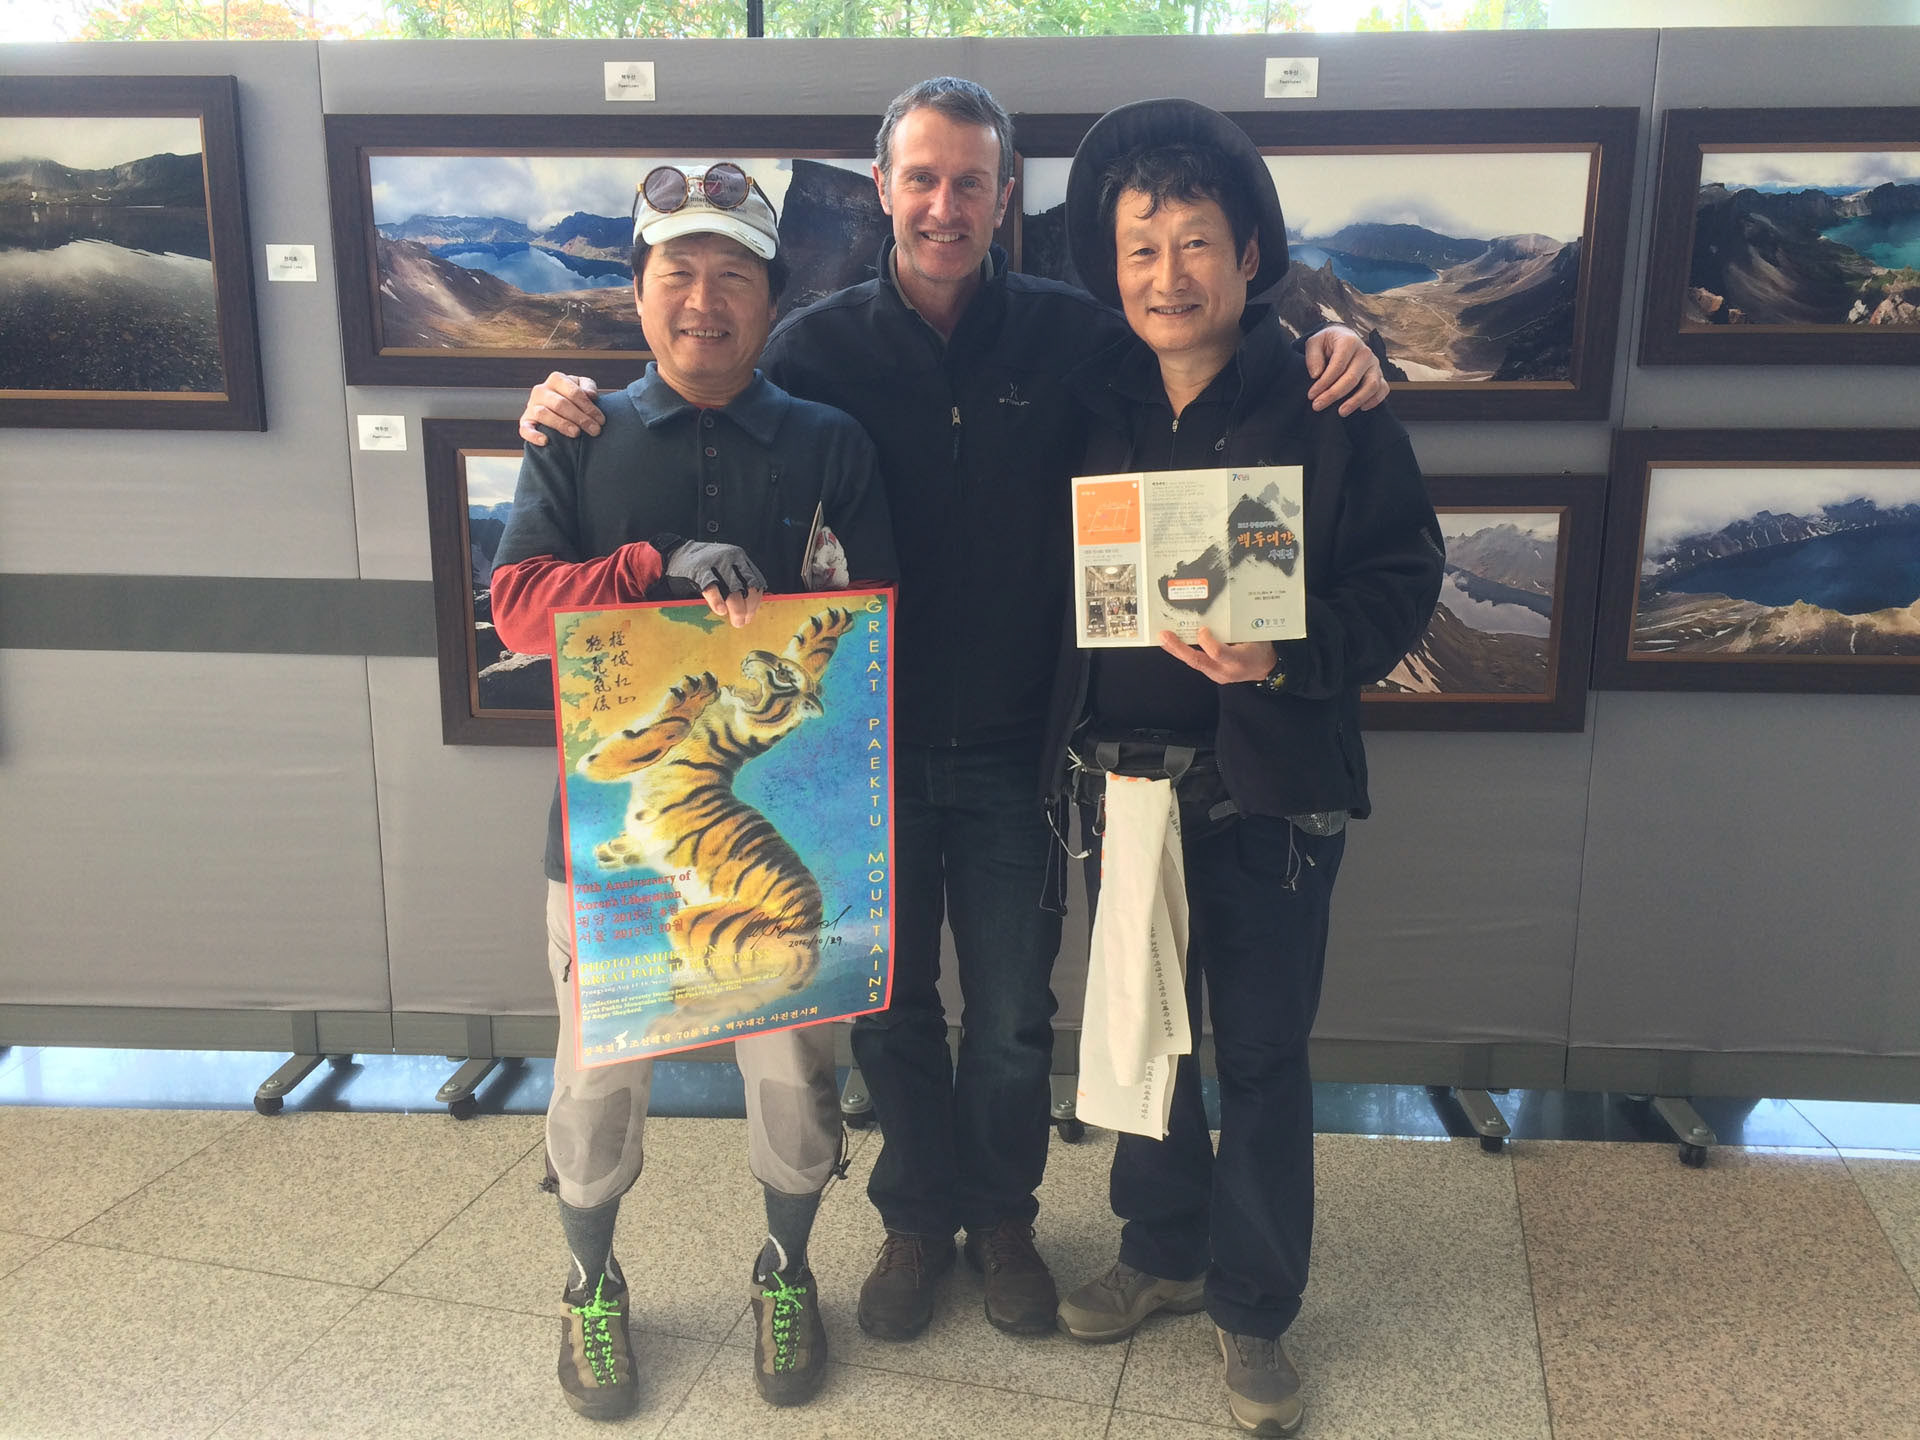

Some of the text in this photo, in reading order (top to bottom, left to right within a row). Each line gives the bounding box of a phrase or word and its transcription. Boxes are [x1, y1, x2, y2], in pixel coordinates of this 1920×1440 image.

[1237, 530, 1295, 548] 백두대간
[865, 600, 885, 1003] GREAT PAEKTU MOUNTAINS
[575, 870, 691, 894] 70th Anniversary of
[621, 890, 682, 906] Liberation
[581, 957, 631, 975] PHOTO
[581, 970, 626, 987] GREAT
[631, 962, 681, 979] PAEKTU
